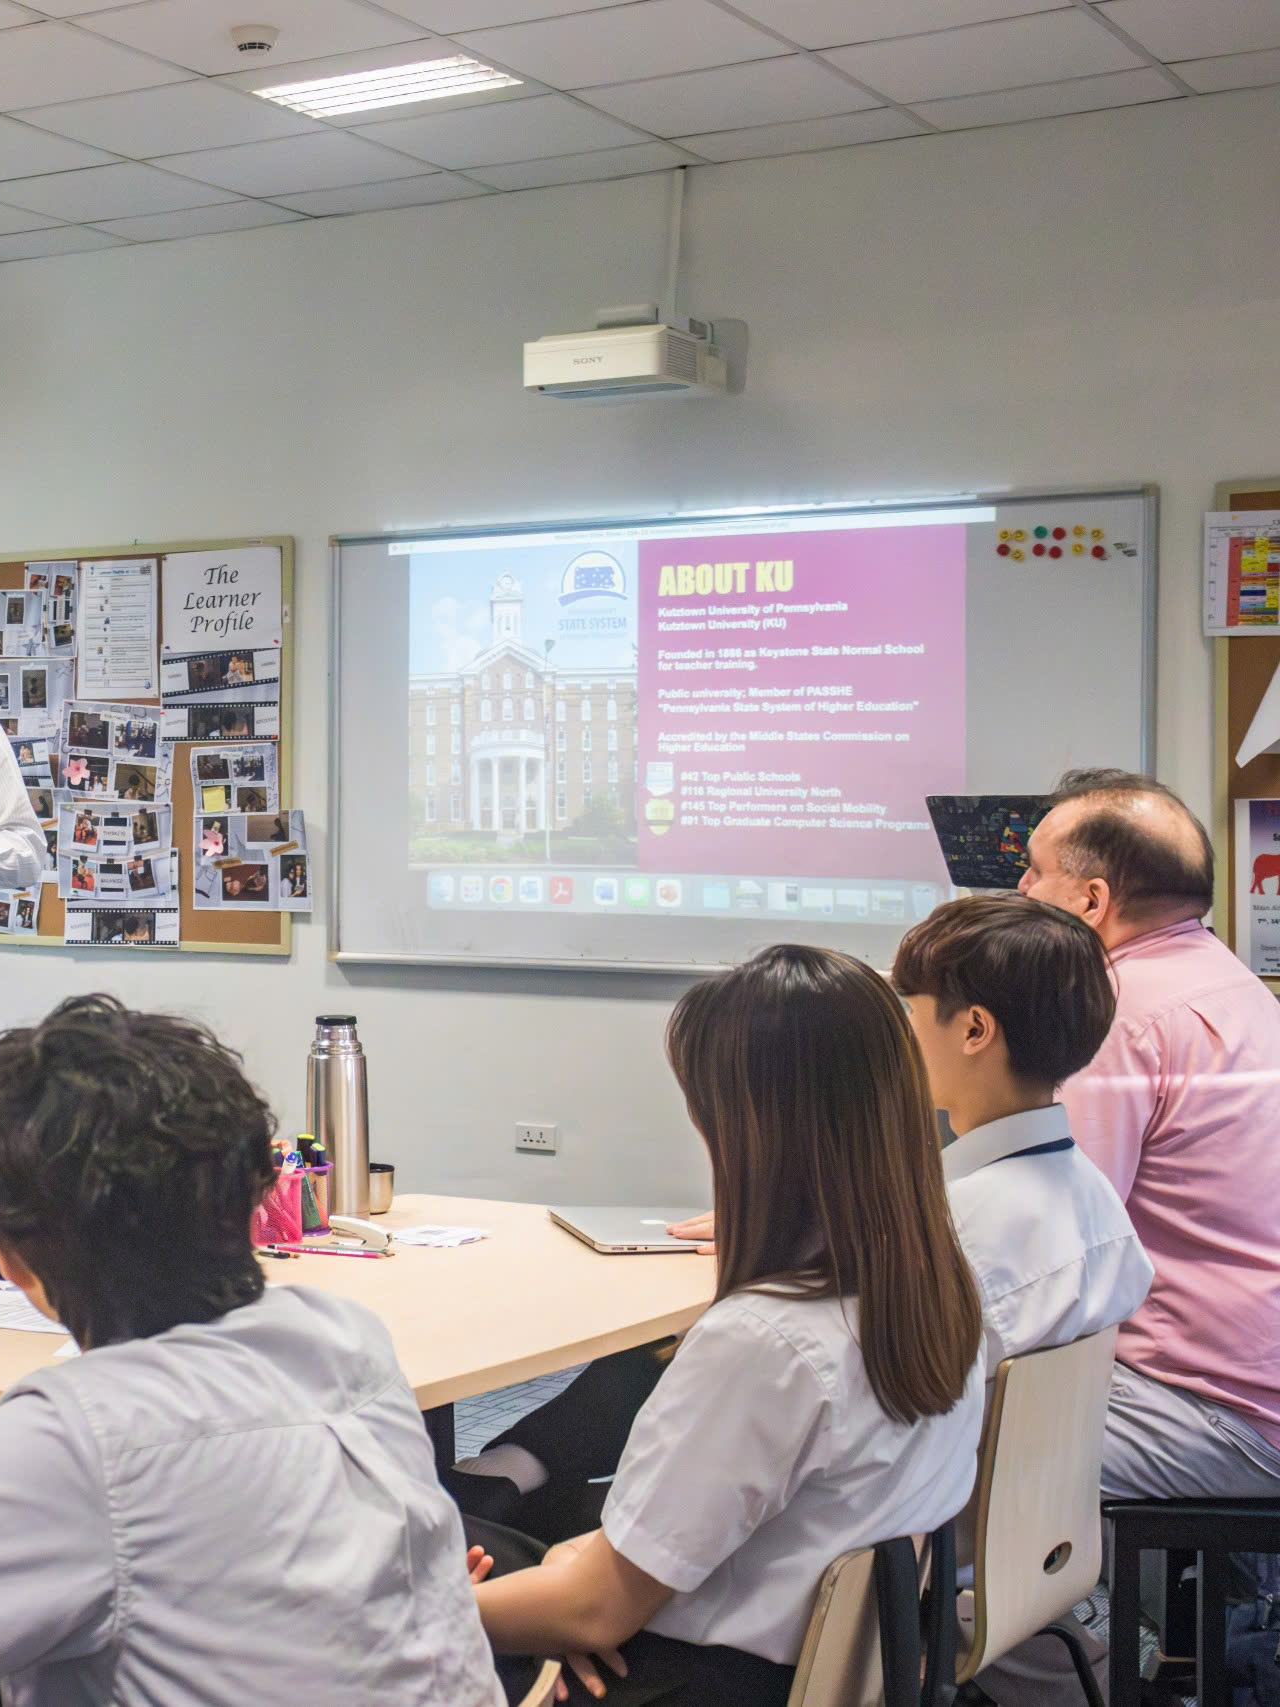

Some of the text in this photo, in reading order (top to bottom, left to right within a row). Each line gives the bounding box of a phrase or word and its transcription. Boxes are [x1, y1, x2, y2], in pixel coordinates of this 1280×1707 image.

[573, 356, 604, 366] SONY
[203, 564, 240, 585] The
[658, 560, 794, 597] ABOUT KU
[183, 591, 261, 611] Learner
[658, 601, 848, 618] Kutztown University of Pennsylvania
[190, 610, 255, 638] Profile
[558, 616, 627, 632] STATE SYSTEM
[658, 617, 787, 631] Kutztown University (KU)
[658, 649, 703, 660] Founded
[704, 648, 716, 659] in
[743, 649, 757, 658] as
[758, 646, 810, 659] Keystone
[811, 645, 840, 656] State
[841, 644, 882, 655] Normal
[884, 643, 925, 654] School
[658, 660, 673, 671] for
[674, 660, 713, 671] teacher
[658, 689, 691, 699] Public
[748, 687, 792, 698] Member
[792, 686, 805, 697] of
[806, 686, 853, 697] PASSHE
[732, 702, 760, 713] State
[761, 702, 802, 714] System
[803, 701, 816, 712] of
[818, 701, 854, 714] Higher
[658, 731, 910, 744] Accredited by the Middle States Commission on
[658, 742, 746, 753] Higher Education
[701, 772, 720, 783] Top
[722, 772, 756, 782] Public
[757, 772, 801, 782] Schools
[706, 787, 753, 799] Regional
[754, 787, 809, 799] University
[811, 788, 842, 797] North
[707, 802, 727, 814] Top
[728, 802, 788, 813] Performers
[790, 804, 804, 813] on
[806, 803, 841, 814] Social
[842, 803, 888, 816] Mobility
[701, 816, 722, 828] Top
[723, 816, 773, 828] Graduate
[774, 817, 828, 829] Computer
[829, 818, 874, 829] Science
[875, 818, 930, 831] Programs
